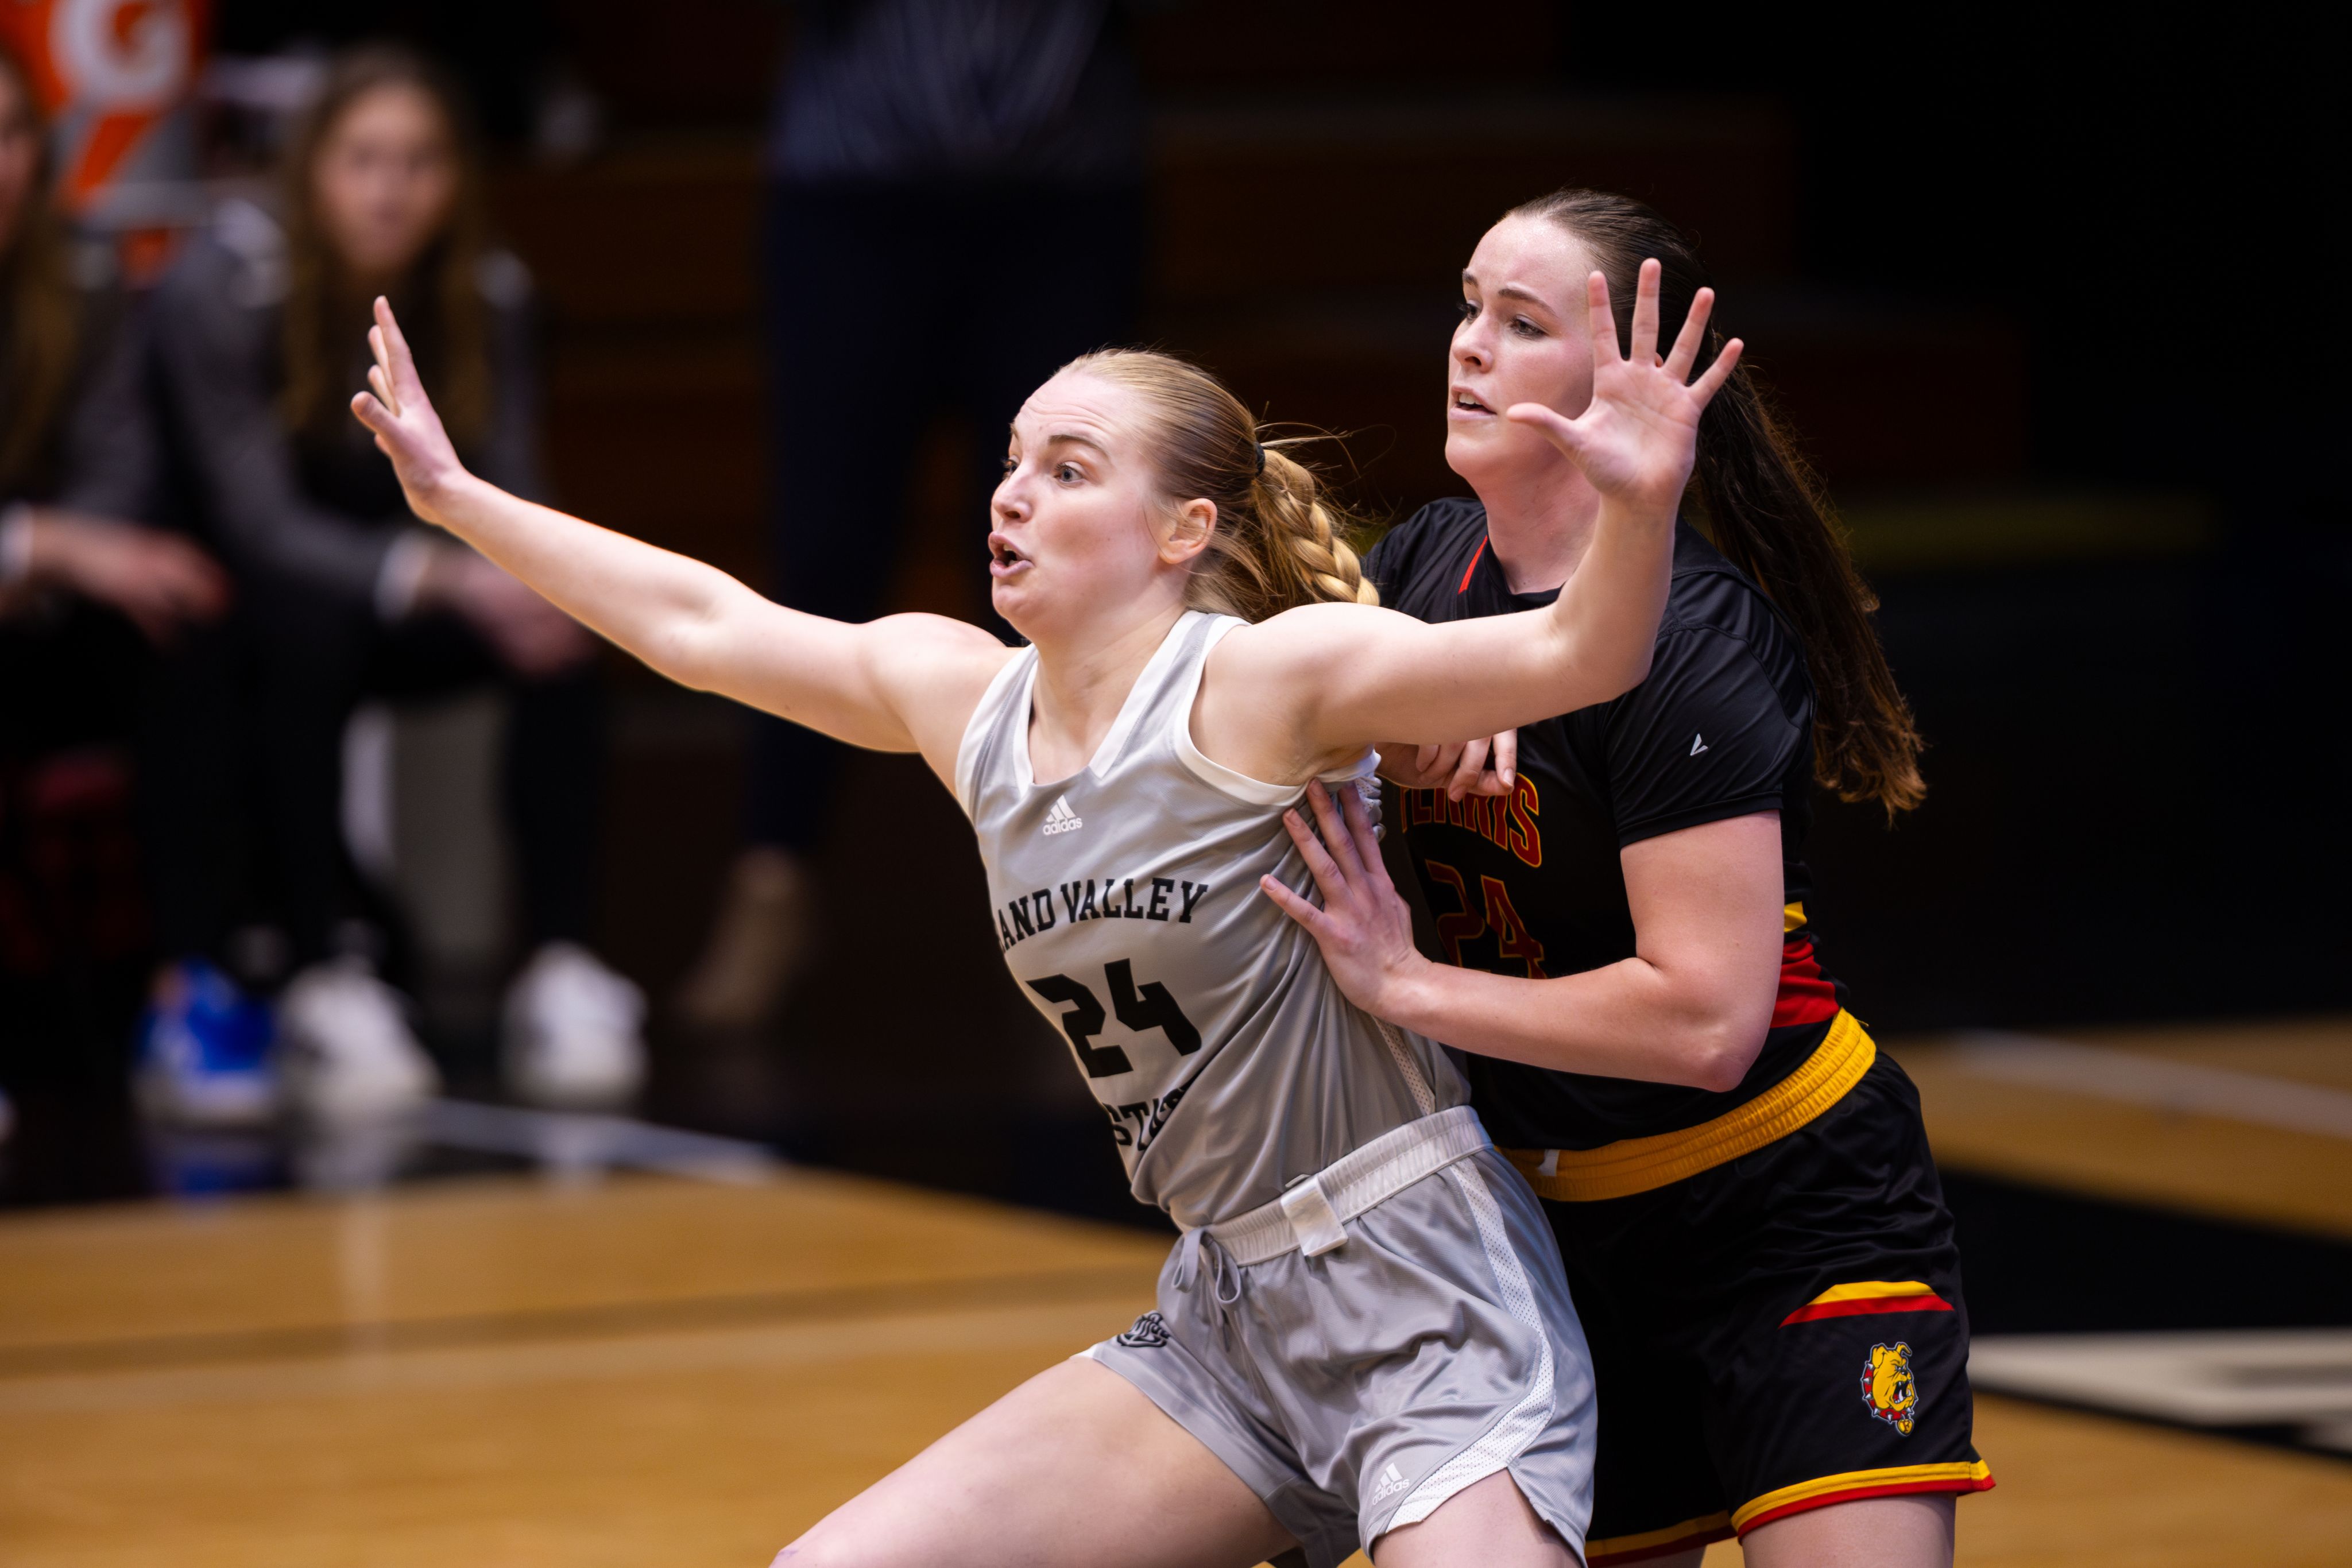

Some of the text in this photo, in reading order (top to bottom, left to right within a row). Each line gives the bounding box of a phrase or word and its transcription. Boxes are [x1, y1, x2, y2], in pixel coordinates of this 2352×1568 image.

[1043, 817, 1082, 835] adidas
[998, 877, 1208, 951] AND VALLEY
[1425, 859, 1547, 979] 24
[1025, 958, 1202, 1078] 24
[1372, 1478, 1410, 1505] adidas
